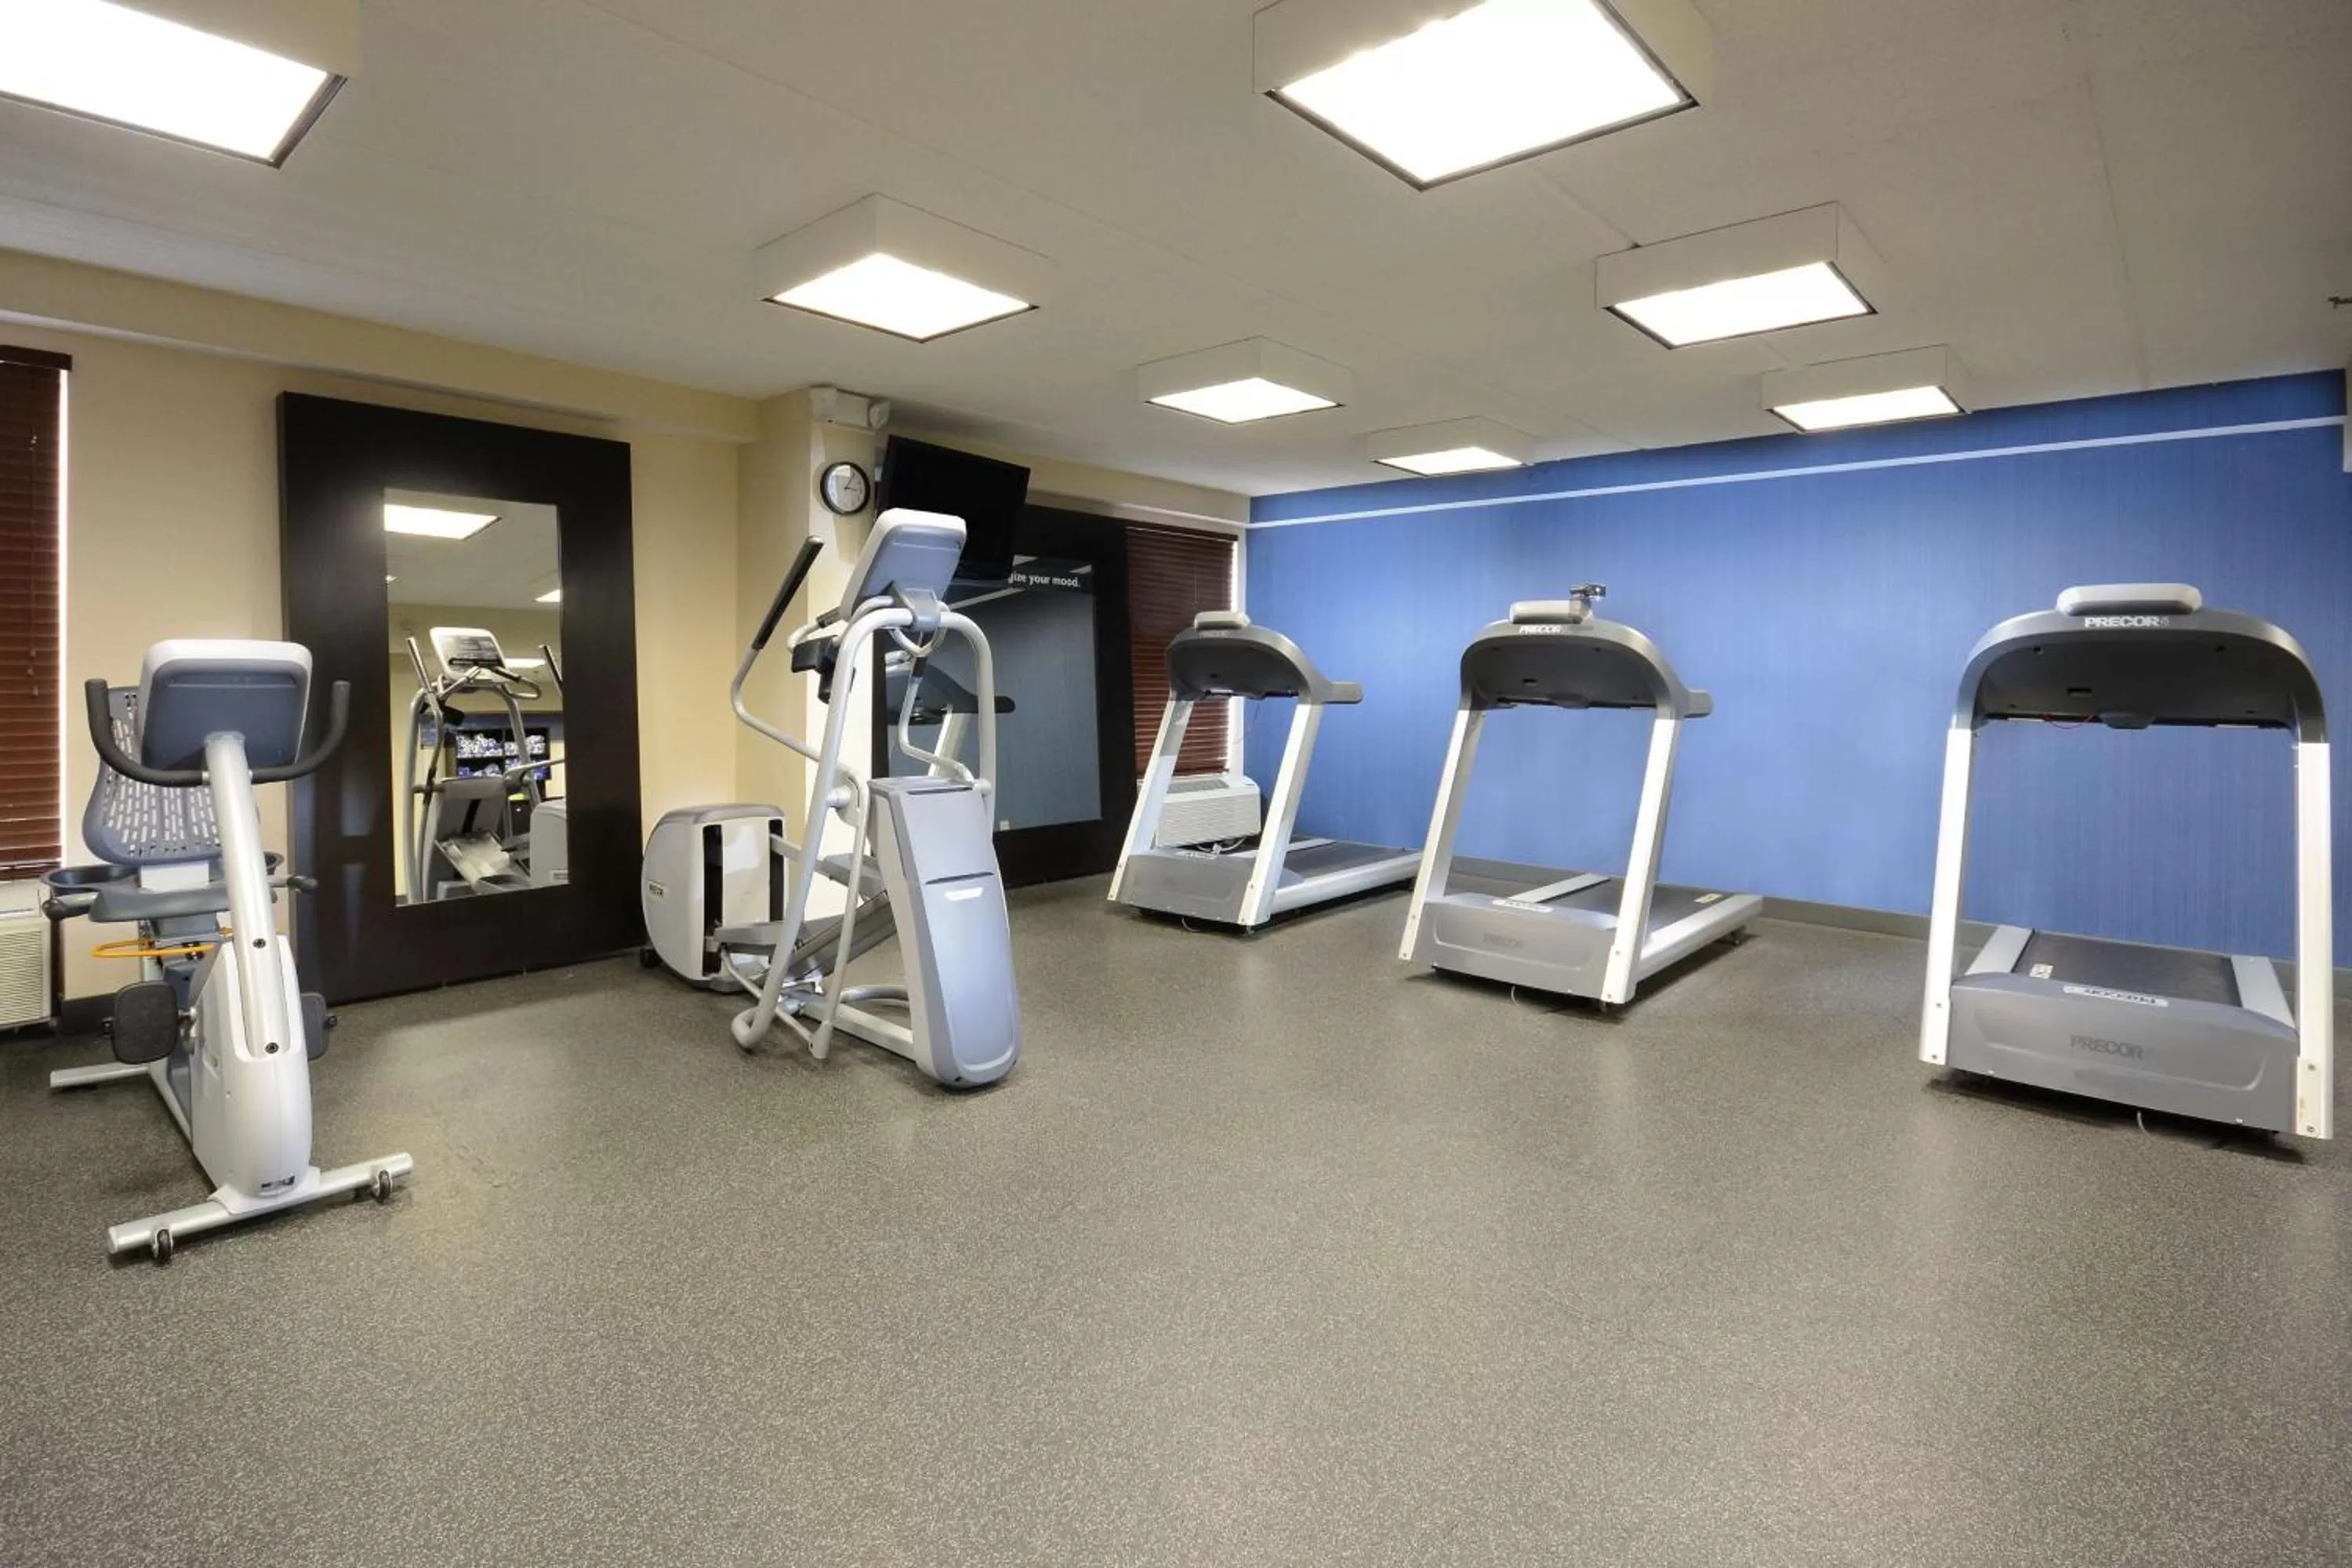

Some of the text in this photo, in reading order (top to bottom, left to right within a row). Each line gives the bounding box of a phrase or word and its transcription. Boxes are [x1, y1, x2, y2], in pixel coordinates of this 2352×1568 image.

[1029, 575, 1051, 586] your
[2085, 615, 2161, 628] PRECOR
[2070, 1034, 2145, 1059] PRECOR
